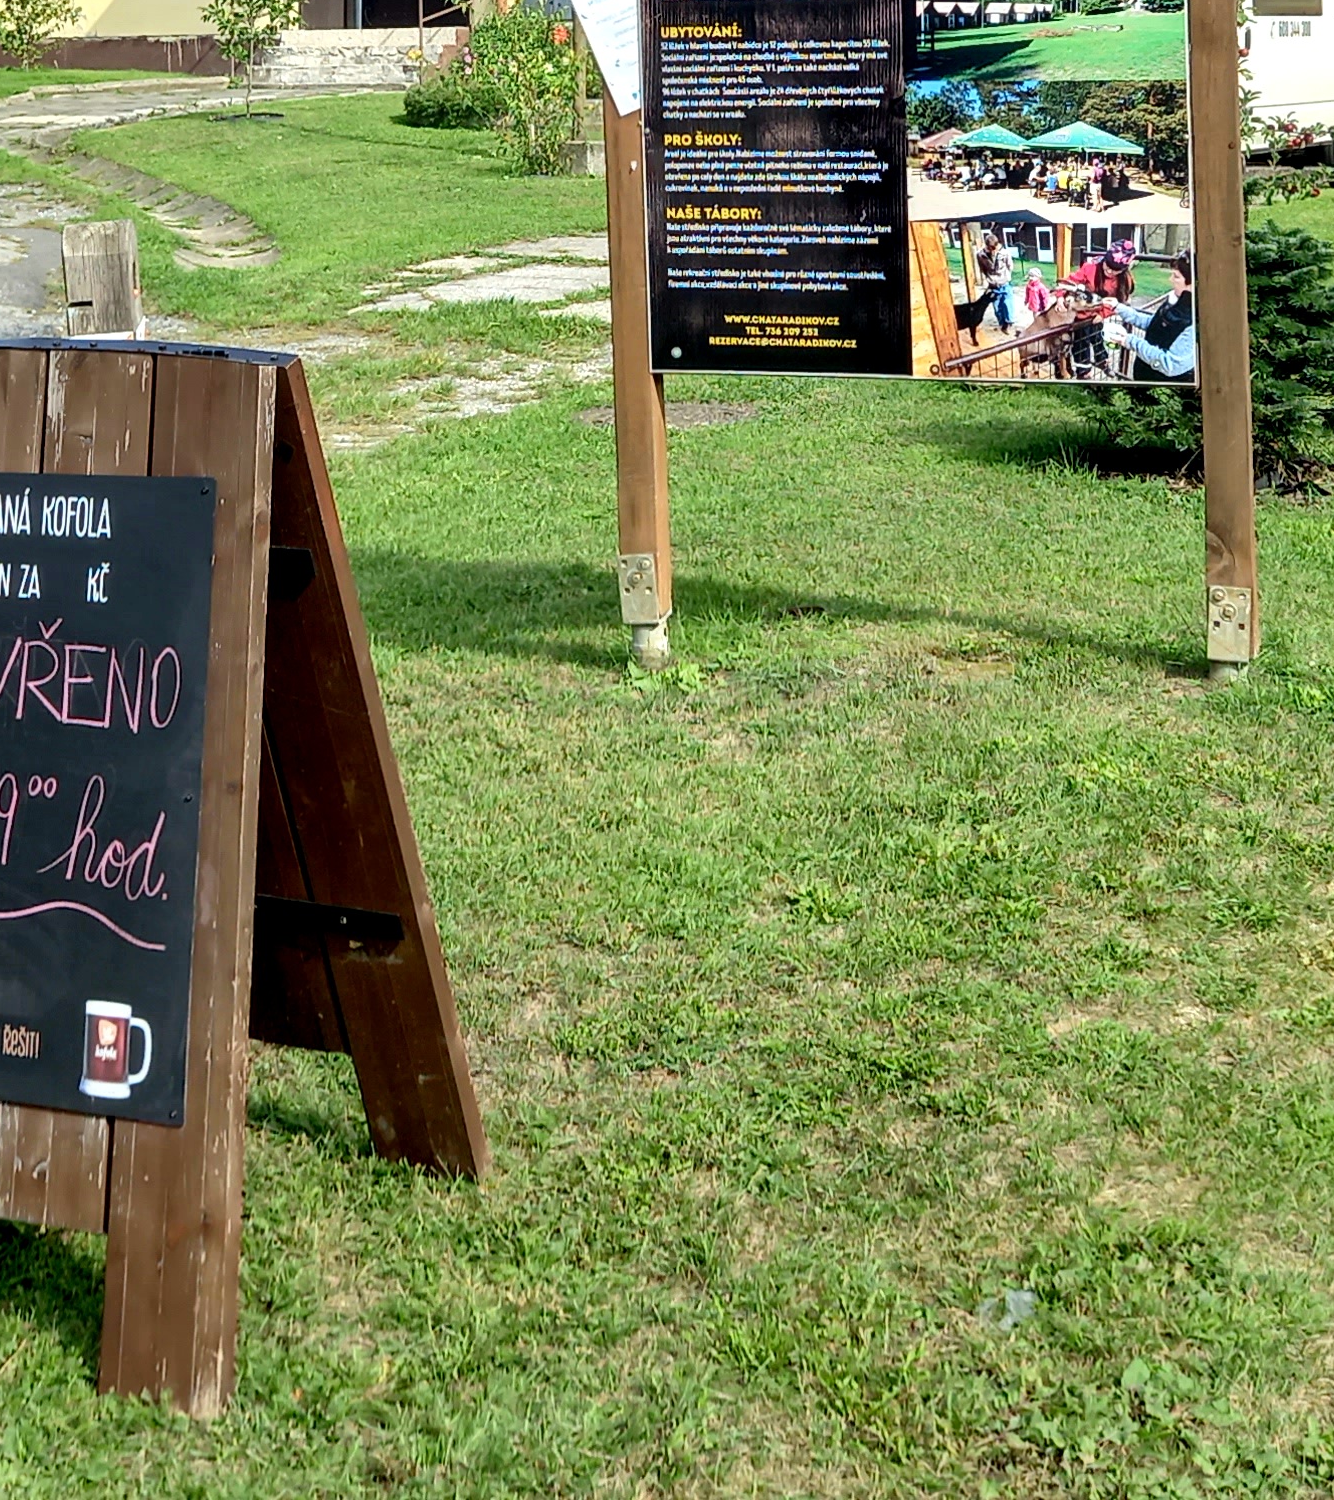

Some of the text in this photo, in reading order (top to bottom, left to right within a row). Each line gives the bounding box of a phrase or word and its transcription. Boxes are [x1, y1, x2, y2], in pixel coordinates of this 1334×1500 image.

[660, 22, 742, 39] UBYTOVÁNÍ:
[664, 130, 742, 146] PRO ŠKOLY:
[667, 204, 762, 220] NAŠE TÁBORY:
[745, 326, 764, 336] TEL.
[41, 495, 112, 539] KOFOLA
[17, 563, 41, 599] ZA
[87, 562, 110, 603] KČ
[36, 774, 167, 901] hod.
